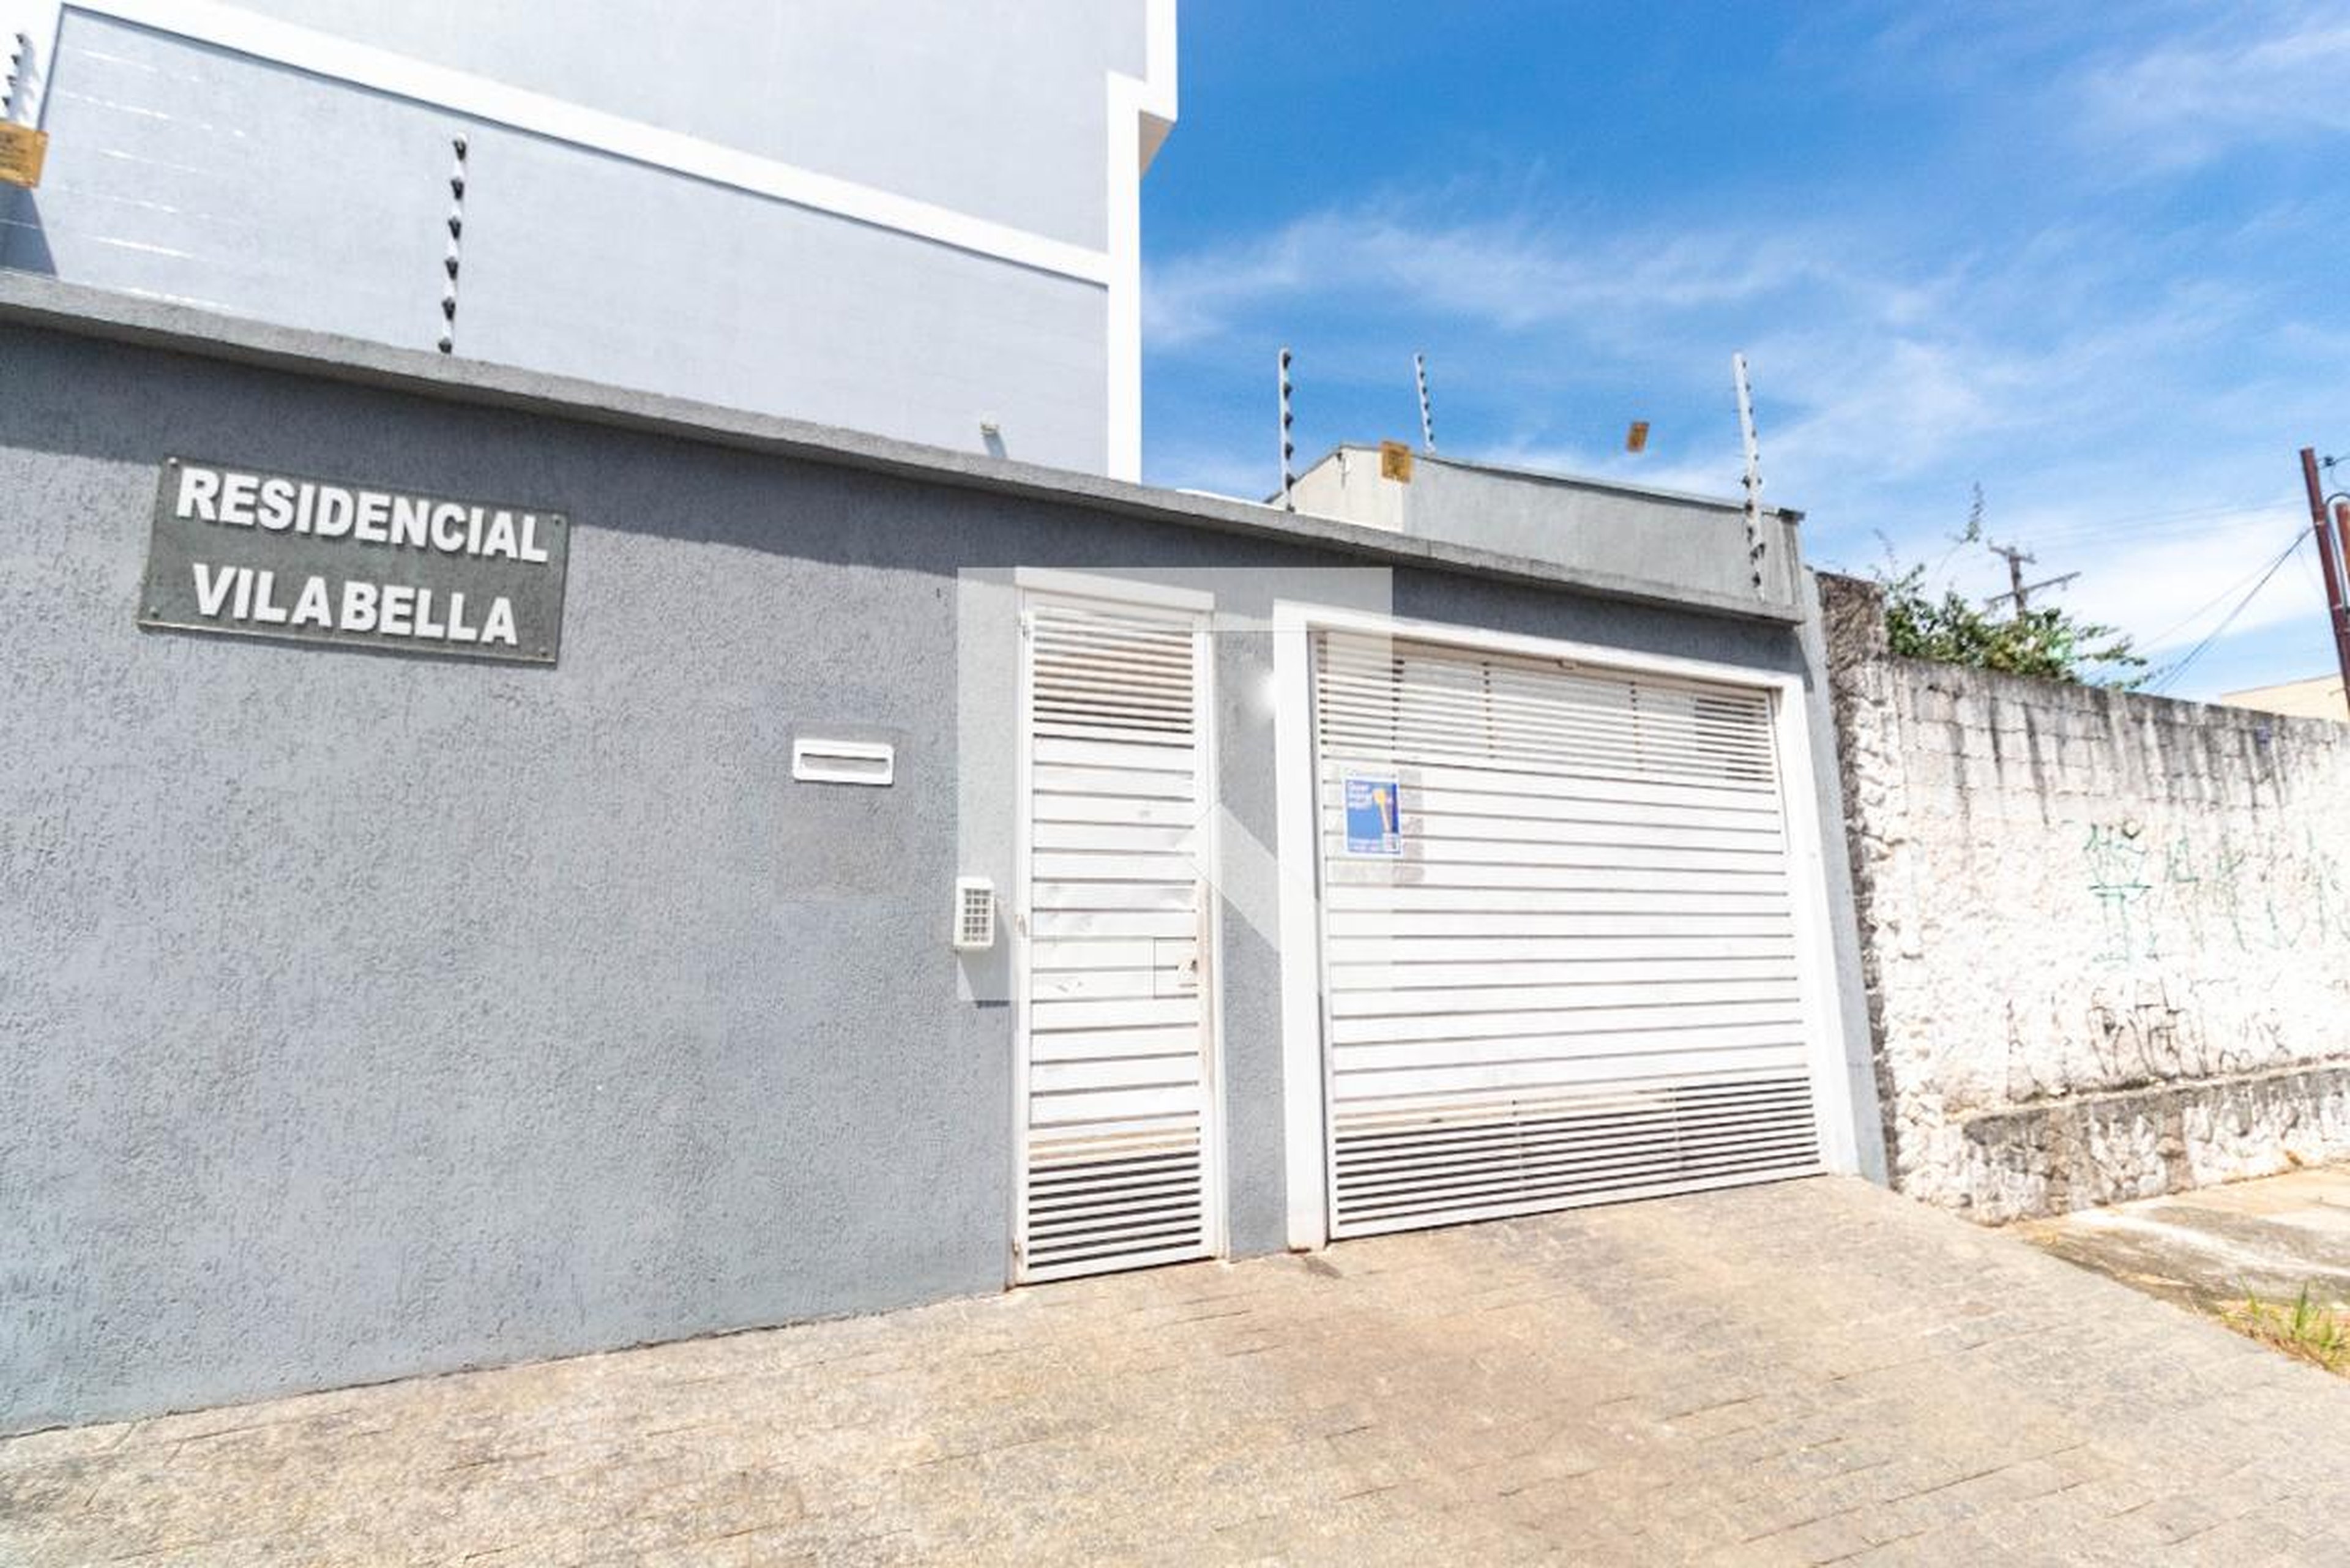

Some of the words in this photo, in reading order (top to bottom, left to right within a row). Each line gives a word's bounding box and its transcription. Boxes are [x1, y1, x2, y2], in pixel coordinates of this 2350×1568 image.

[176, 468, 548, 562] RESIDENCIAL
[193, 563, 332, 627] VILA
[340, 580, 518, 646] BELLA
